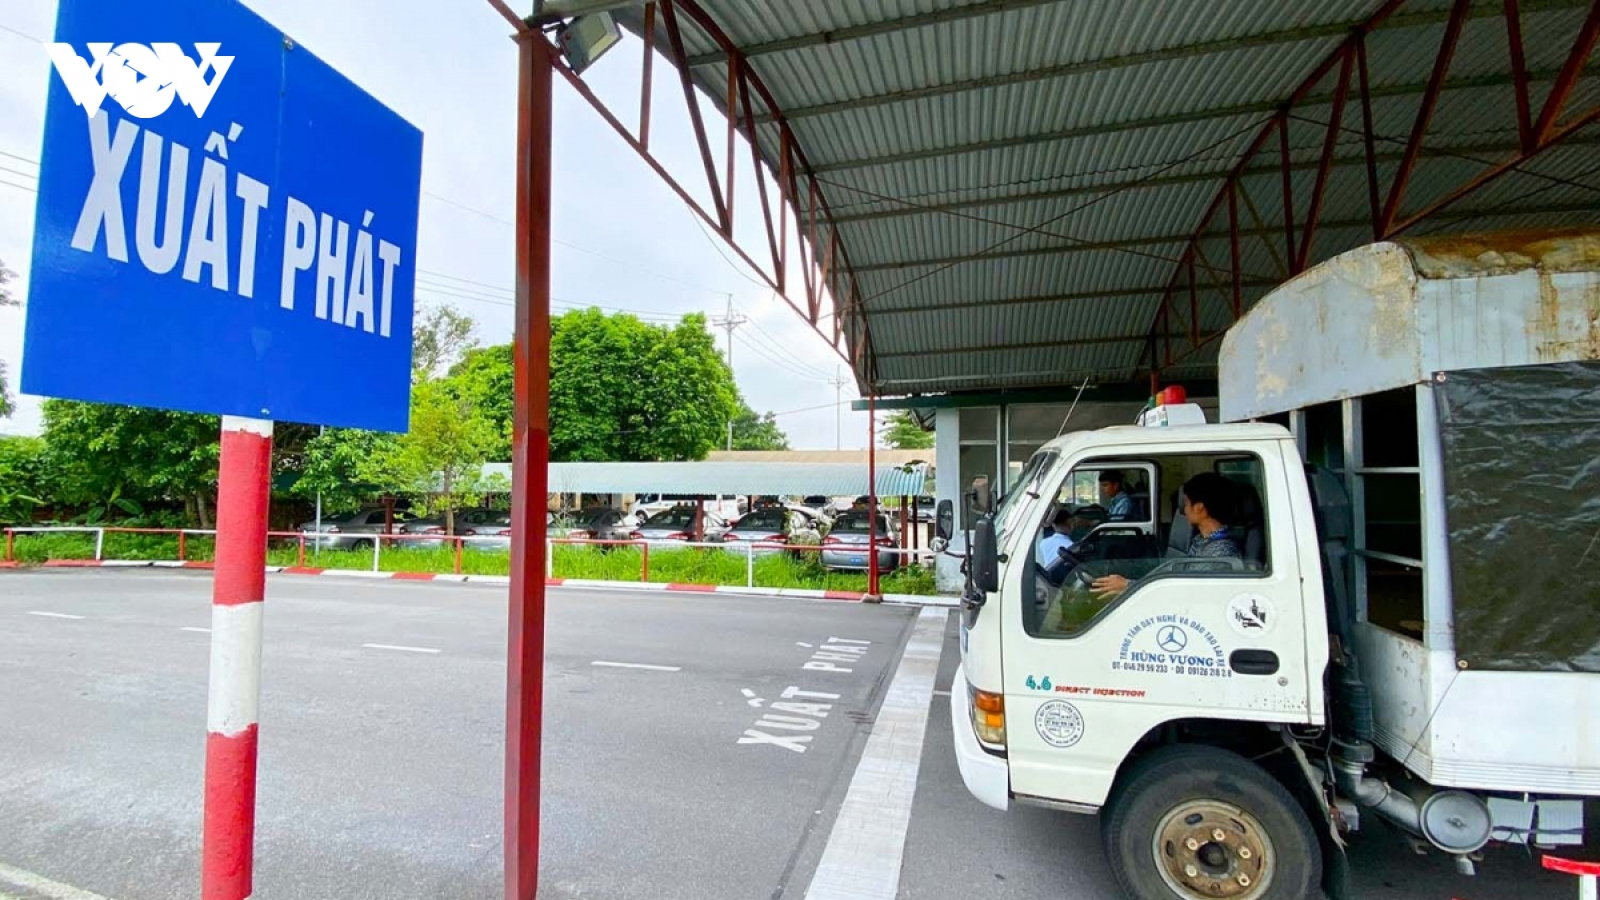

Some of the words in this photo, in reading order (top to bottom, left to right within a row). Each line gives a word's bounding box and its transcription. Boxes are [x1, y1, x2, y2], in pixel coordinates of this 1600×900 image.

[71, 107, 269, 299] XUẤT
[280, 196, 401, 338] PHÁT
[1025, 674, 1052, 691] 4.6
[1055, 685, 1092, 695] DIRECT
[1092, 687, 1146, 698] INJECTION
[1131, 650, 1166, 663] HÙNG
[1169, 654, 1214, 667] VƯƠNG
[737, 686, 841, 753] XUẤT
[795, 636, 872, 673] PHÁT
